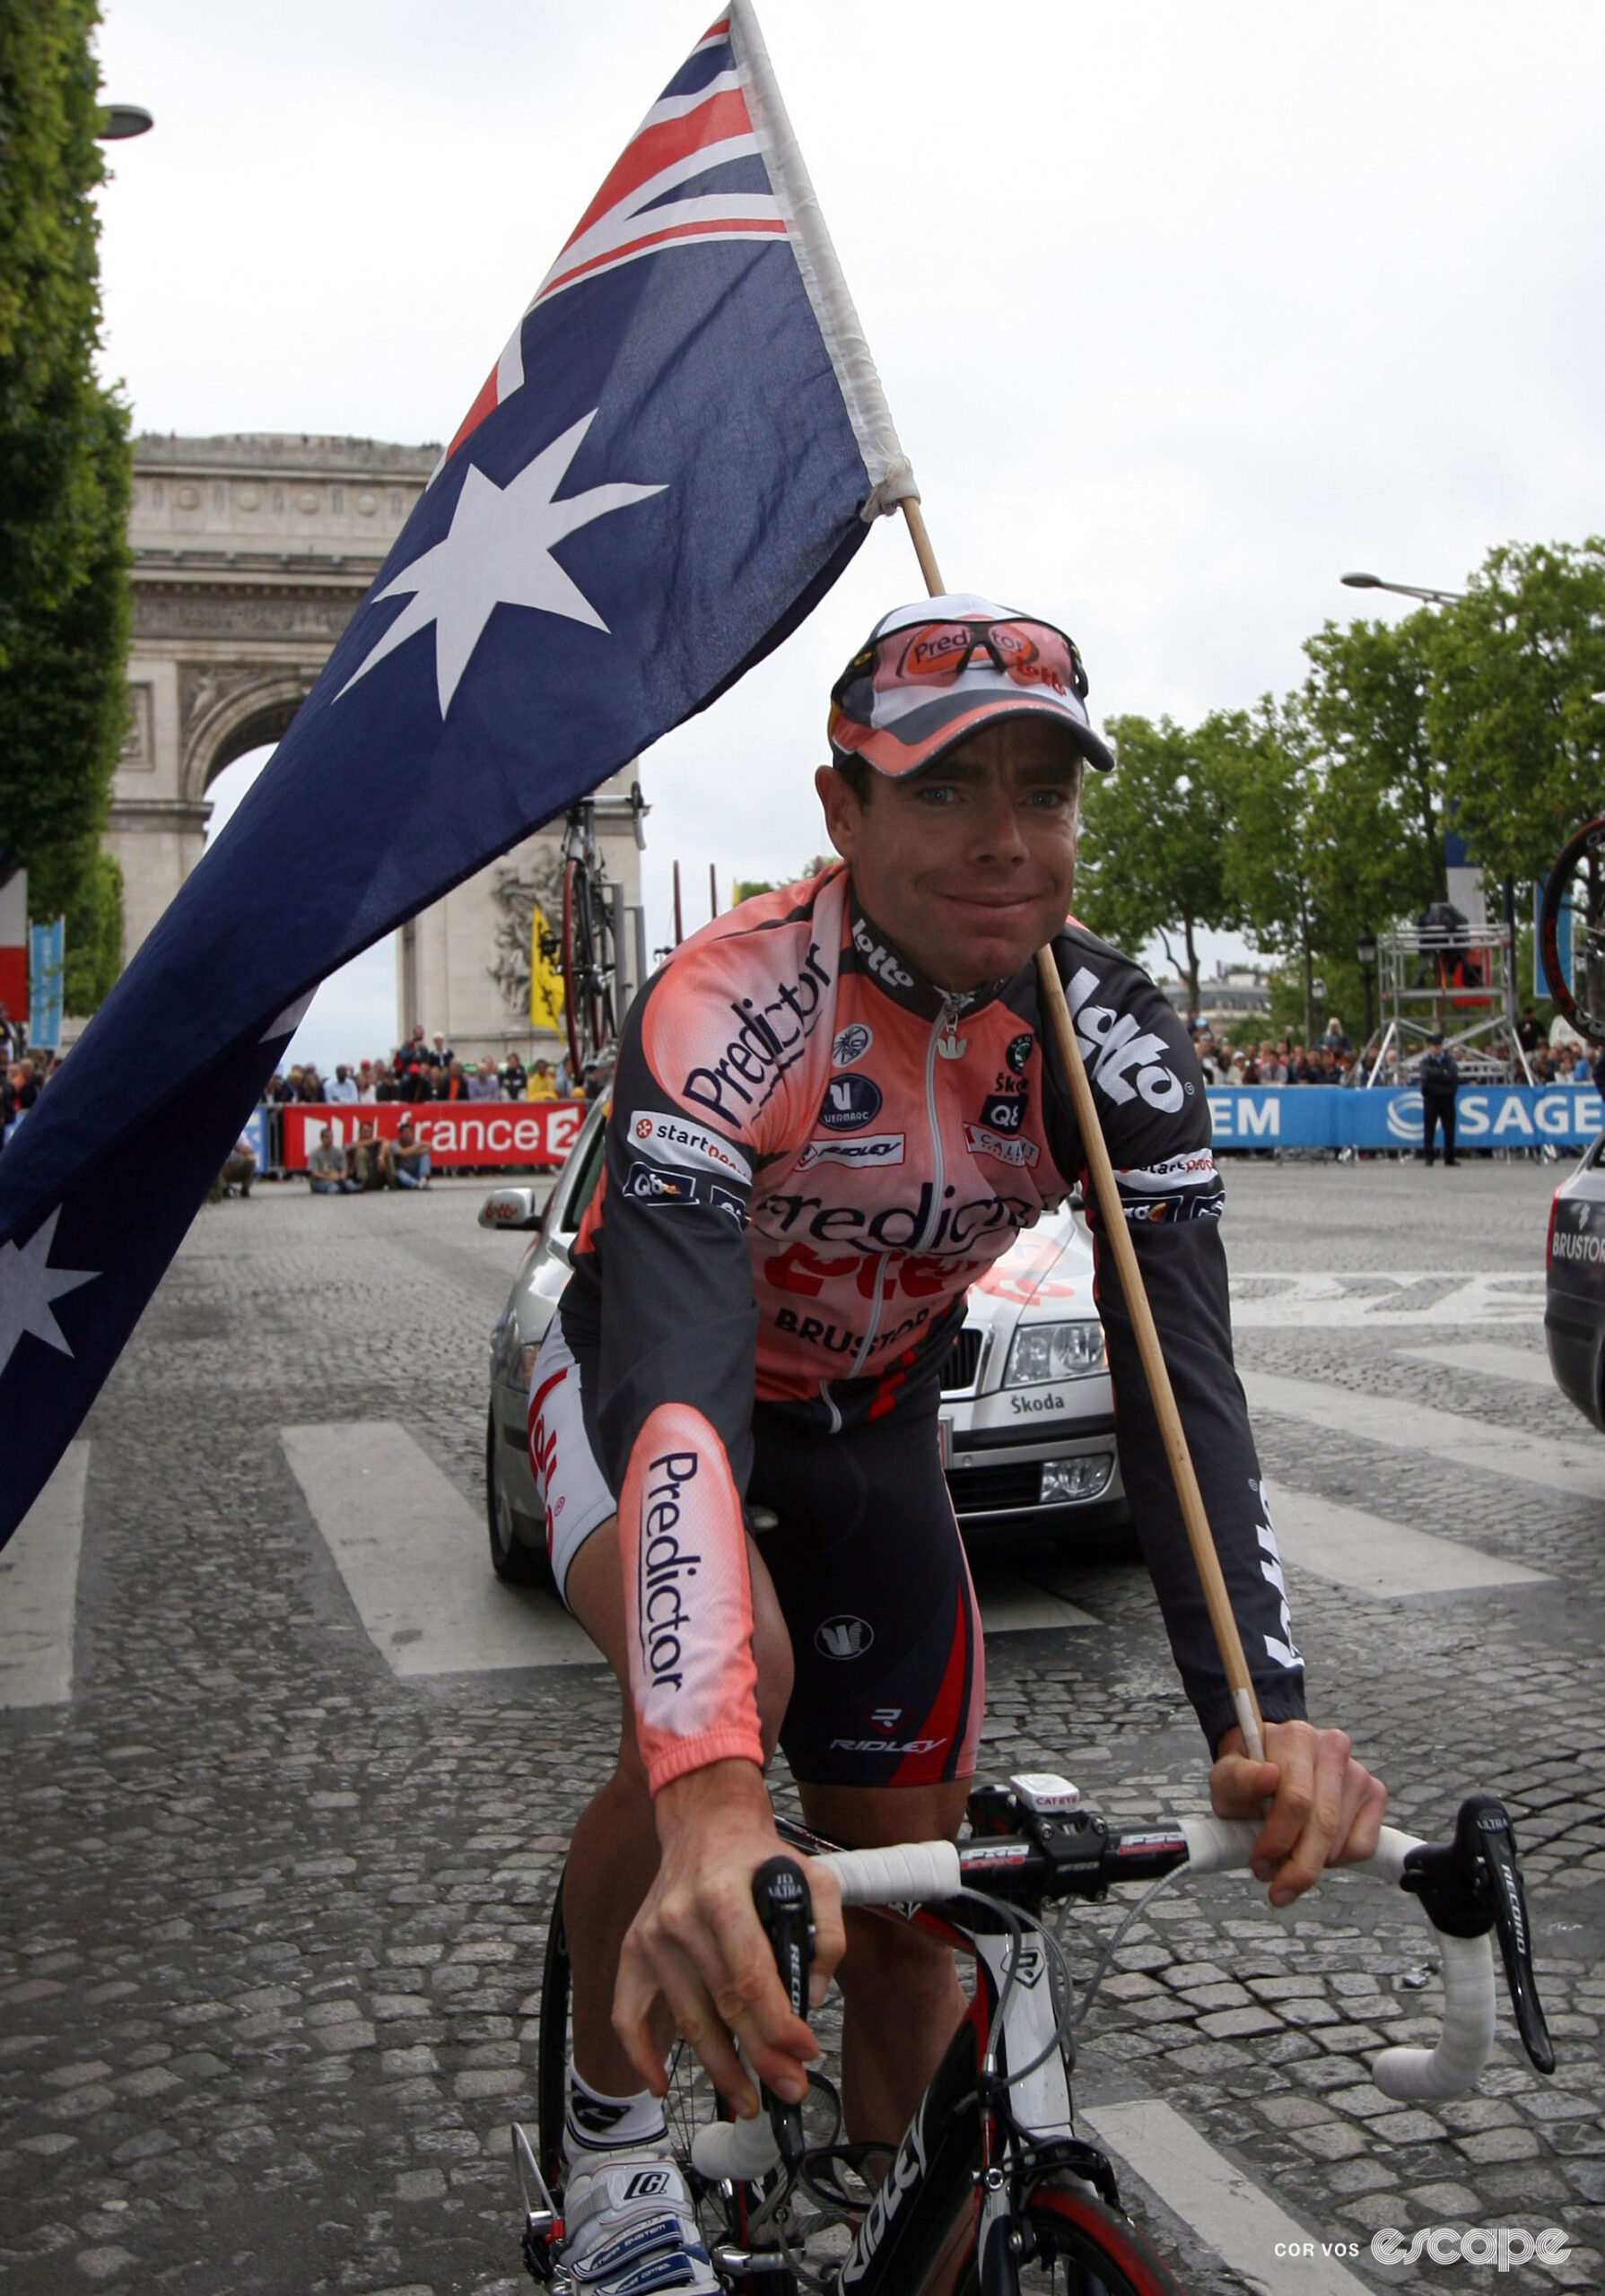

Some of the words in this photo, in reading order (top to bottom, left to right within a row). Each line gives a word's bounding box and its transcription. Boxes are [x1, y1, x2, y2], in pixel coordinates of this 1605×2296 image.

[852, 918, 914, 987] lotto
[682, 943, 831, 1129] Predictor
[824, 1111, 869, 1122] VERMARC
[397, 1111, 538, 1152] france
[818, 1142, 902, 1157] RIDLEY
[1011, 1393, 1065, 1414] Škoda
[645, 1452, 702, 1692] Predictor
[829, 1738, 947, 1753] RIDLEY
[1035, 1796, 1077, 1806] CATEYE
[1478, 1818, 1508, 1831] ULTRA
[768, 1885, 803, 1898] ULTRA
[1502, 1864, 1526, 1954] RECORD
